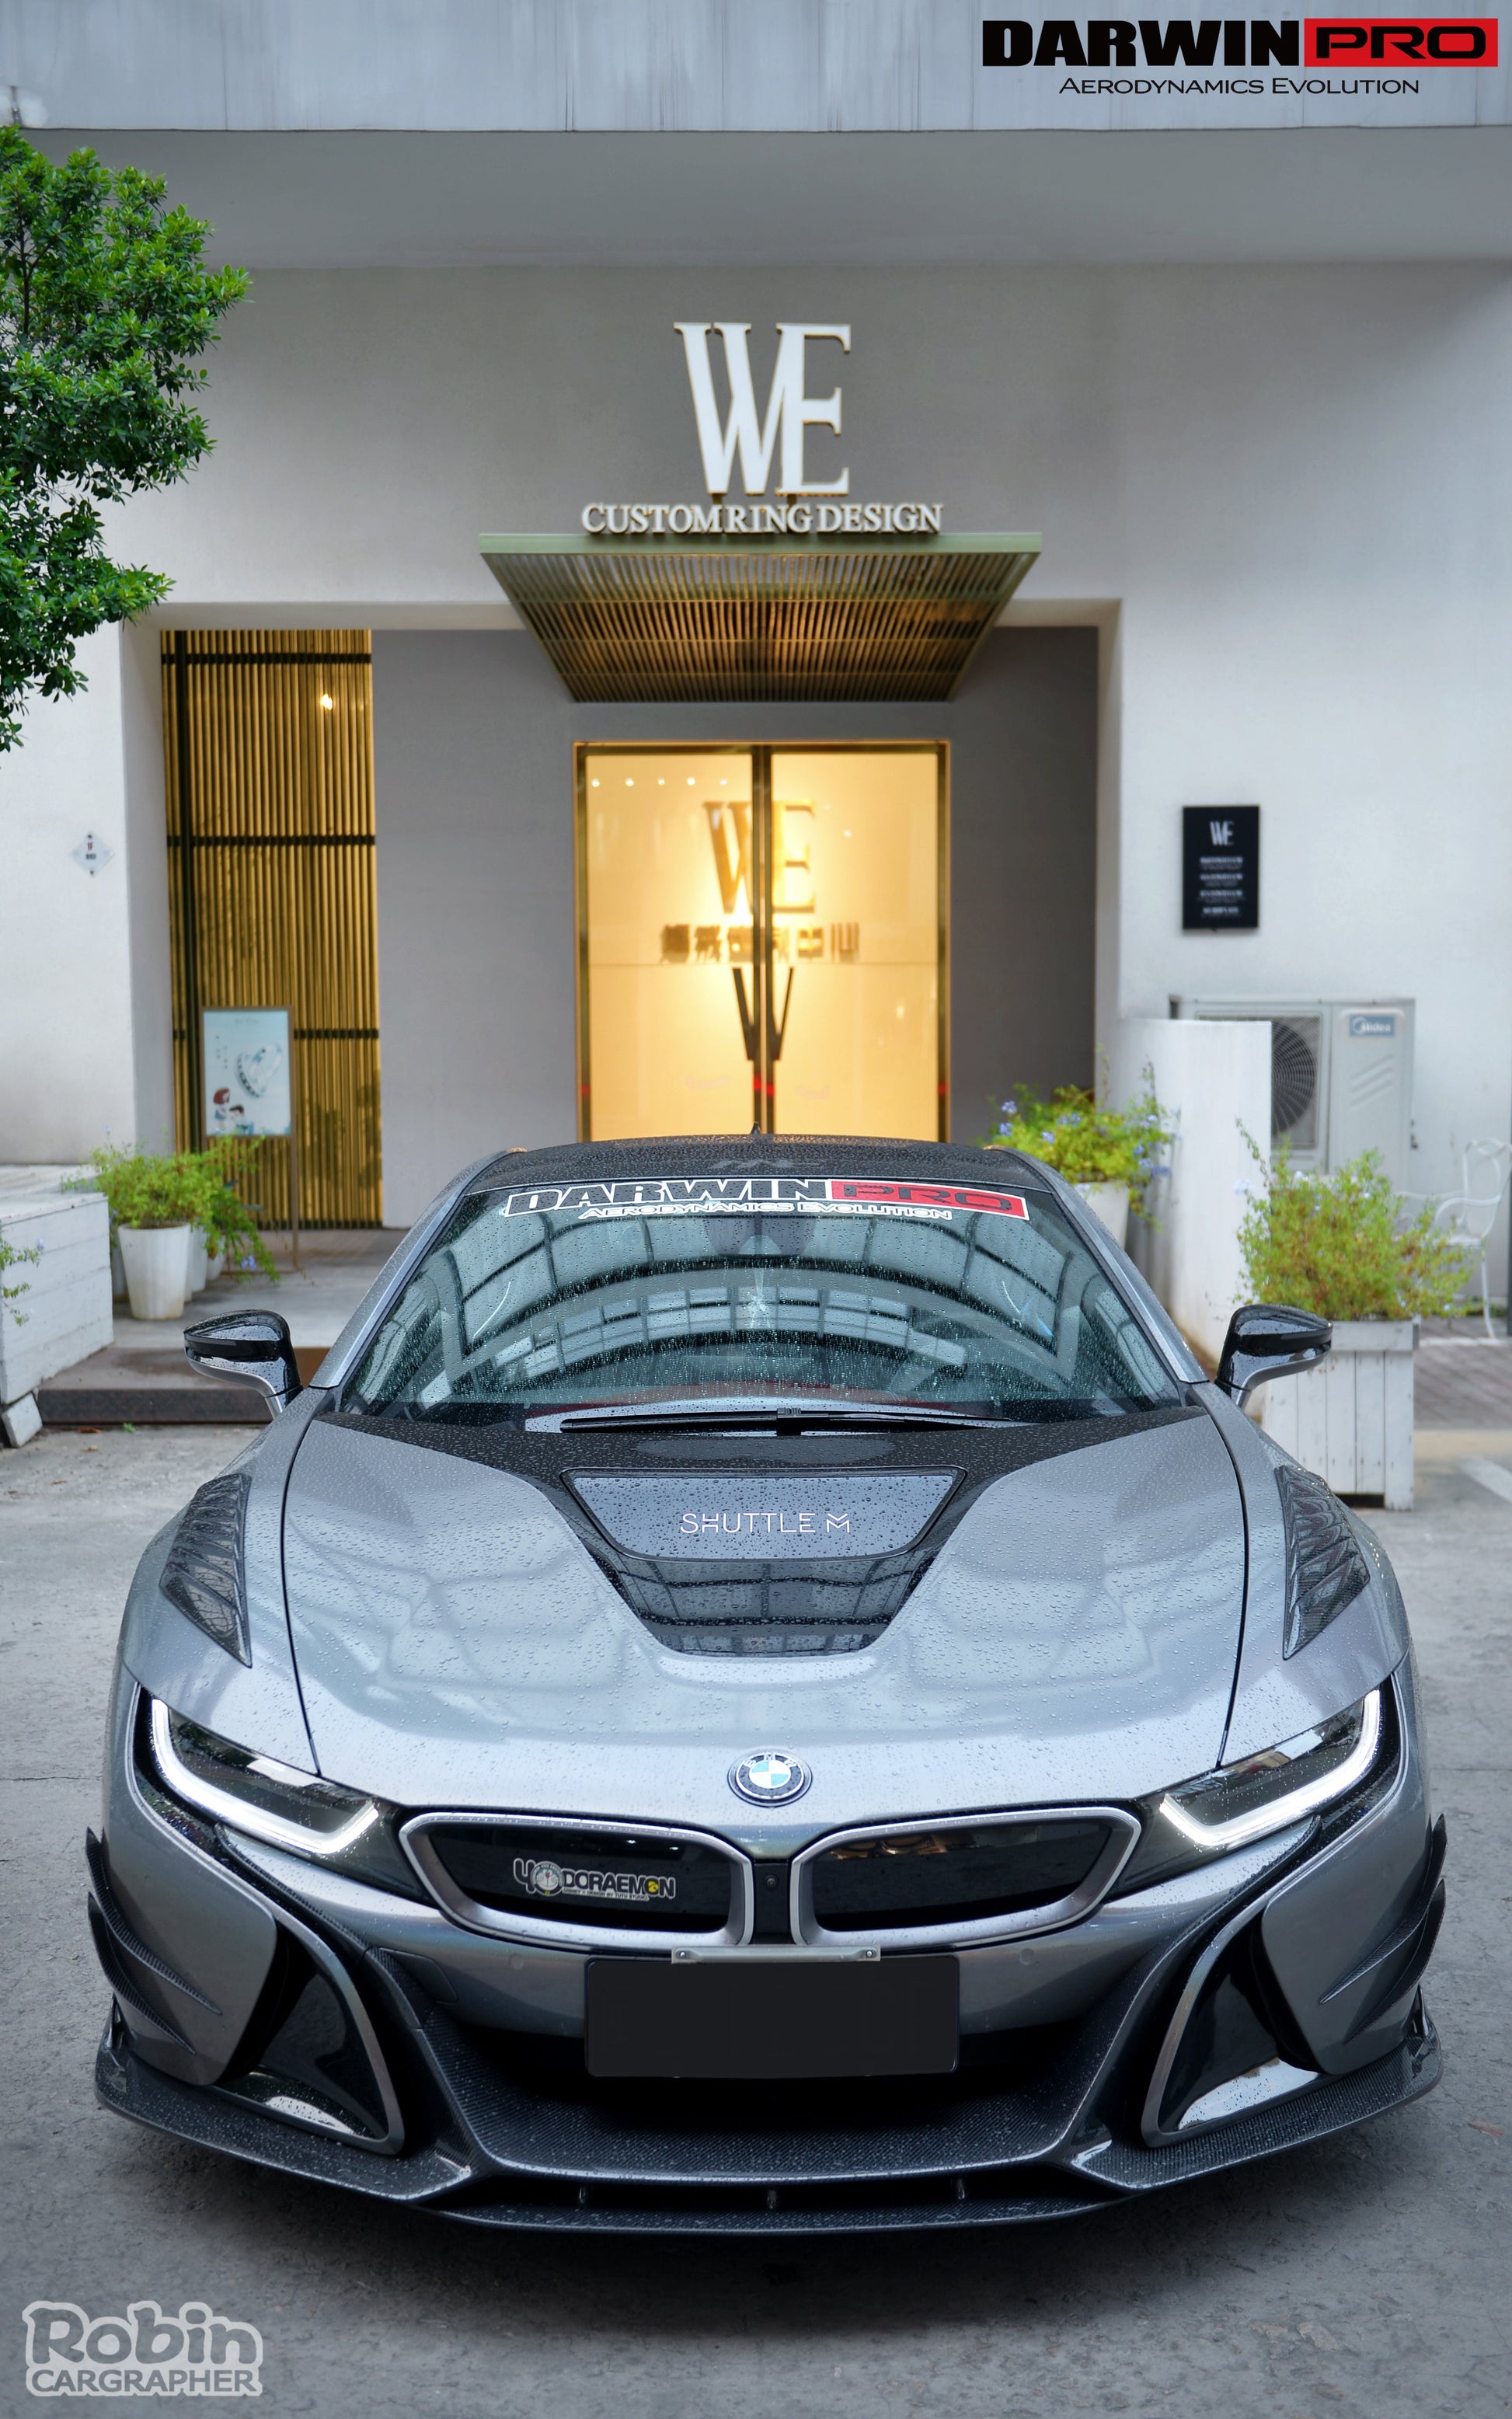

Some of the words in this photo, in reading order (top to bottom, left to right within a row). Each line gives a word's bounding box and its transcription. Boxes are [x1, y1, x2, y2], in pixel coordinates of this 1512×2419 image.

[674, 322, 852, 496] WE
[581, 502, 722, 534] CUSTOM
[723, 504, 813, 535] RING
[816, 504, 943, 535] DESIGN
[505, 1179, 830, 1218] DARWIN
[844, 1183, 1012, 1211] PRO
[578, 1202, 795, 1220] AERODYNAMICS
[797, 1203, 953, 1221] EVOLUTION
[680, 1513, 816, 1533] SHUTTLE
[826, 1513, 850, 1533] M
[744, 1752, 797, 1769] BMW
